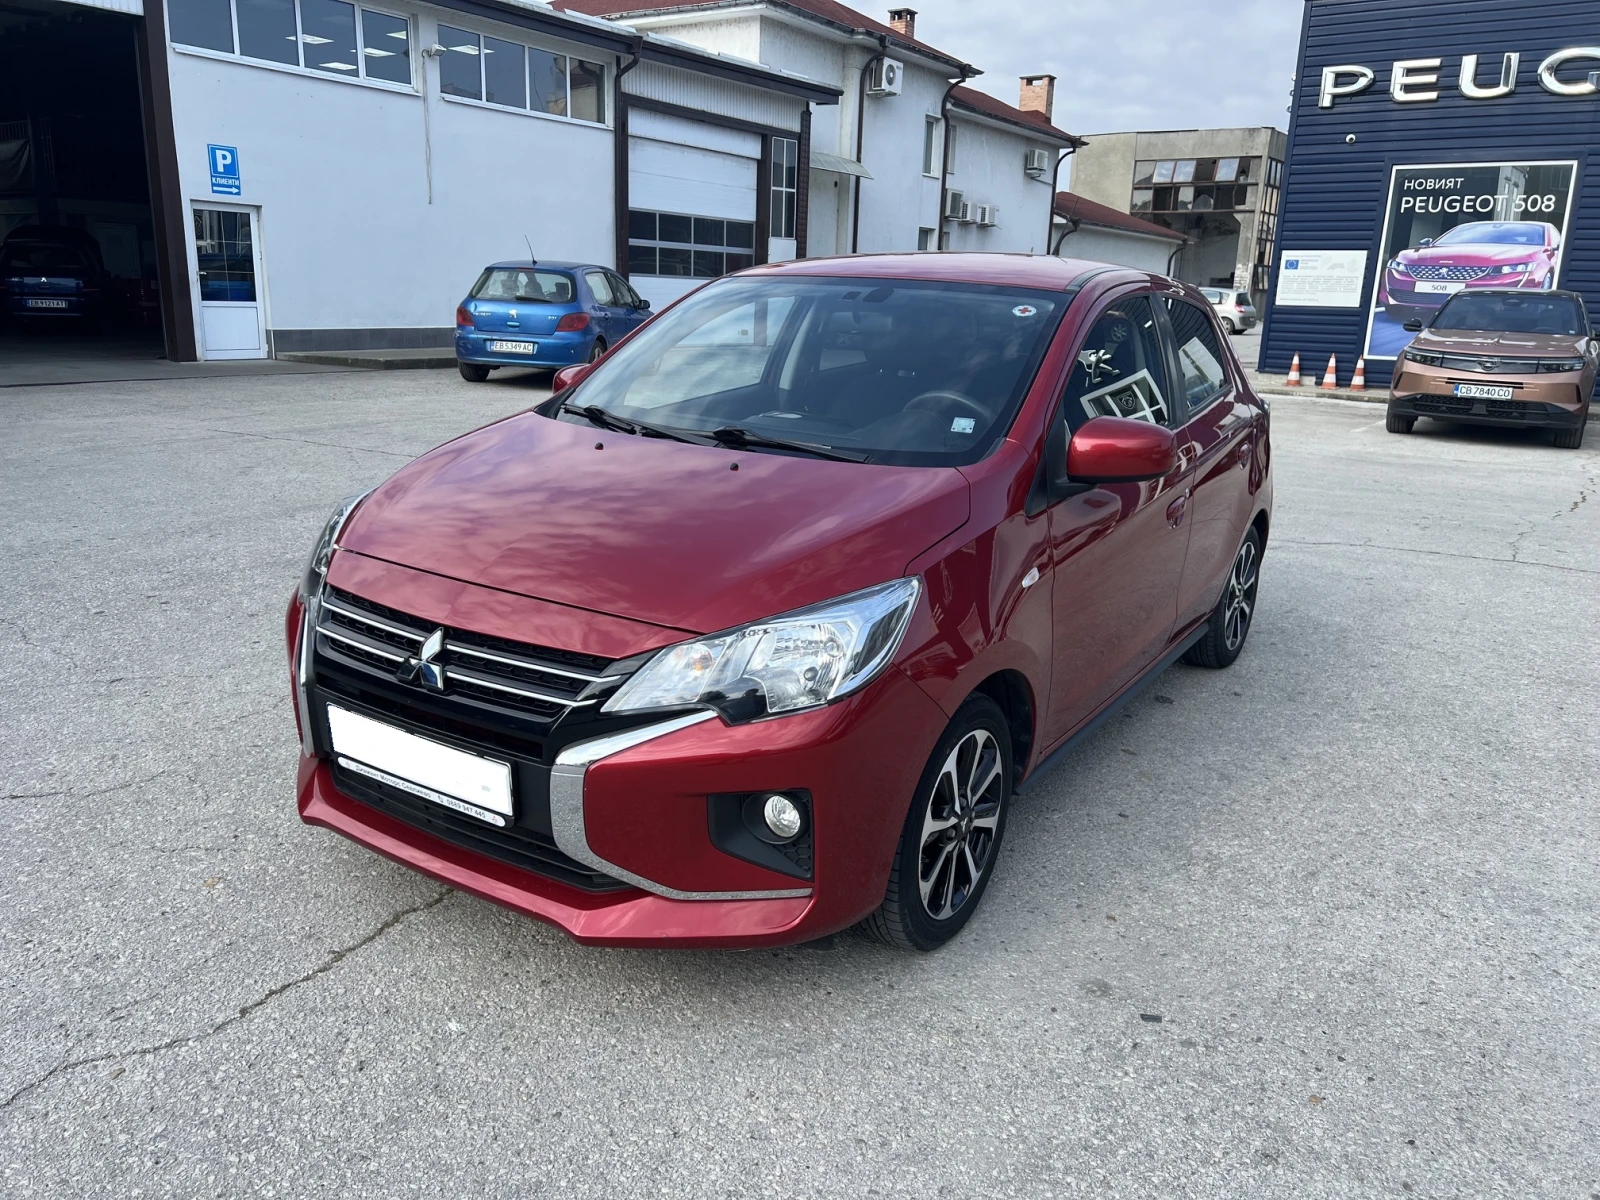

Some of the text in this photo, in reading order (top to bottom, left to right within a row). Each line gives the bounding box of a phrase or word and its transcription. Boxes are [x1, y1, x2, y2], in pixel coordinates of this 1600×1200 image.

[1318, 47, 1600, 108] PEUG
[215, 149, 232, 172] P
[211, 176, 240, 186] КЛИЕНТИ
[1404, 178, 1464, 190] НОВИЯТ
[1400, 194, 1555, 213] PEUGEOT 508
